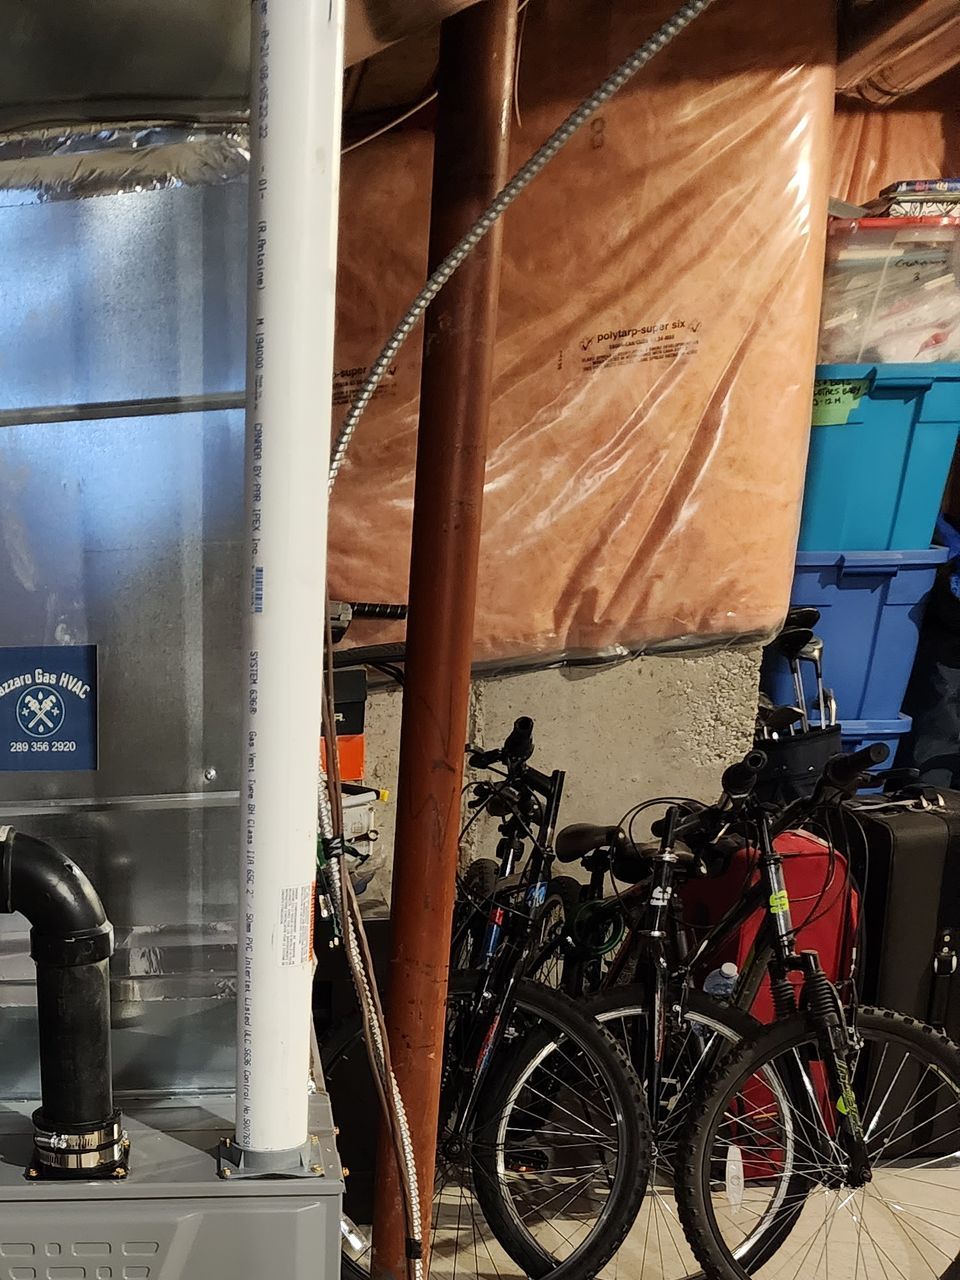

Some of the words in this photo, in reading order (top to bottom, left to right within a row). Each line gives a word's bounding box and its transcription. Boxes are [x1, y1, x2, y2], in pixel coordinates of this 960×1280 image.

[672, 319, 686, 330] six
[253, 422, 263, 461] CANADA
[251, 508, 262, 532] IPEX
[248, 650, 259, 686] SYSTEM
[35, 668, 57, 684] Gas
[58, 672, 91, 700] HVAC
[10, 741, 29, 753] 289
[31, 741, 49, 752] 356
[51, 740, 77, 752] 2920
[248, 730, 258, 748] Gas
[247, 752, 257, 774] Vent
[245, 779, 257, 800] Type
[247, 803, 256, 815] BH
[246, 818, 256, 845] Class
[245, 849, 256, 865] IIA
[244, 936, 254, 952] PVC
[243, 956, 254, 993] Intertek
[243, 997, 253, 1027] Listed
[242, 1069, 252, 1101] Control
